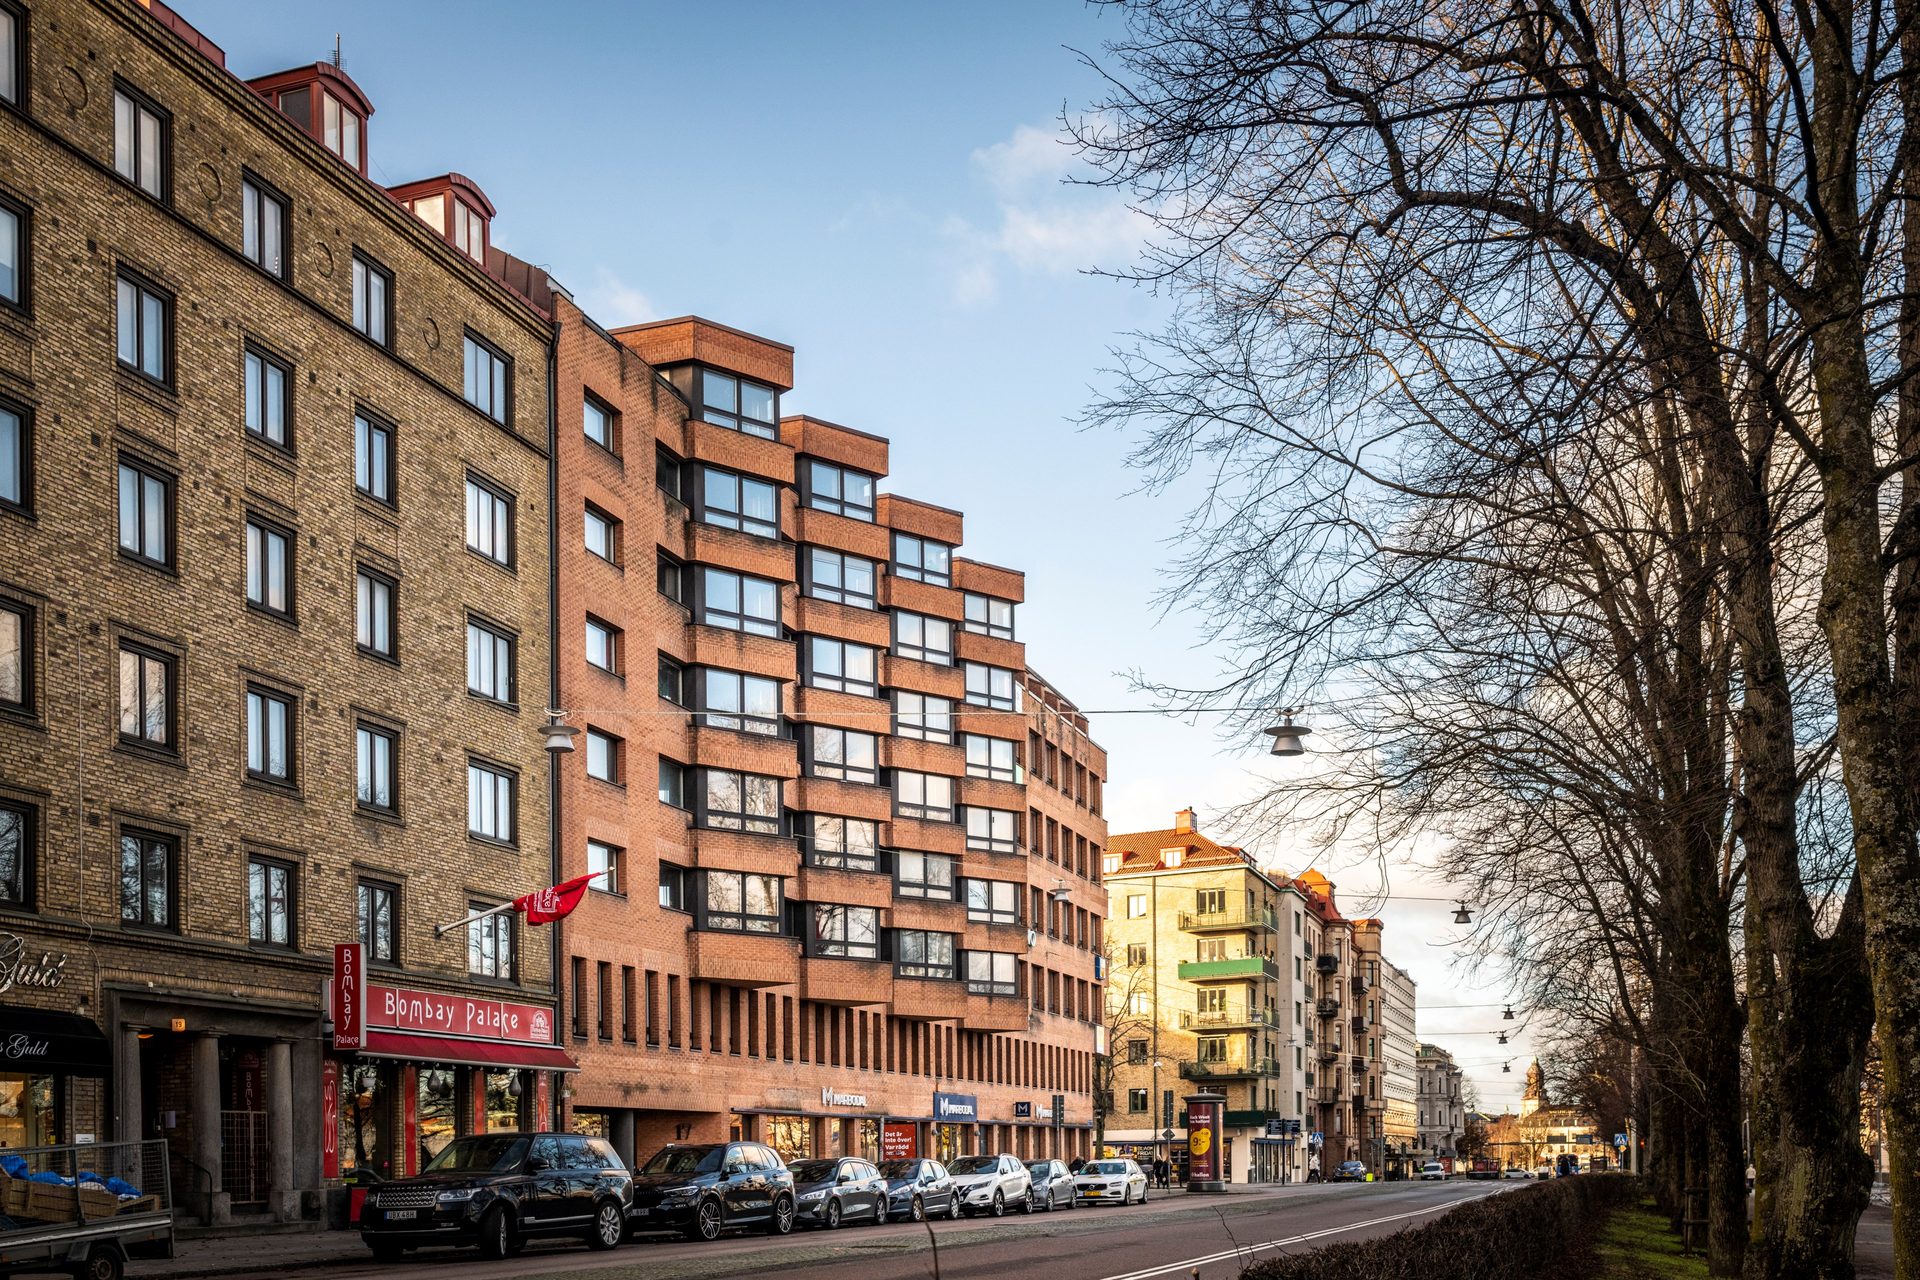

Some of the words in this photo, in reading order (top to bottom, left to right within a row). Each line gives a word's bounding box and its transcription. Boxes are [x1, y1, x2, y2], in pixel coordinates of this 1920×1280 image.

[542, 886, 555, 907] alace
[341, 949, 354, 1030] Bombay
[385, 992, 454, 1028] Bombay
[467, 1002, 518, 1033] Palace
[6, 1034, 49, 1058] Guld
[336, 1035, 359, 1047] Palace
[834, 1094, 867, 1107] MARBODAL
